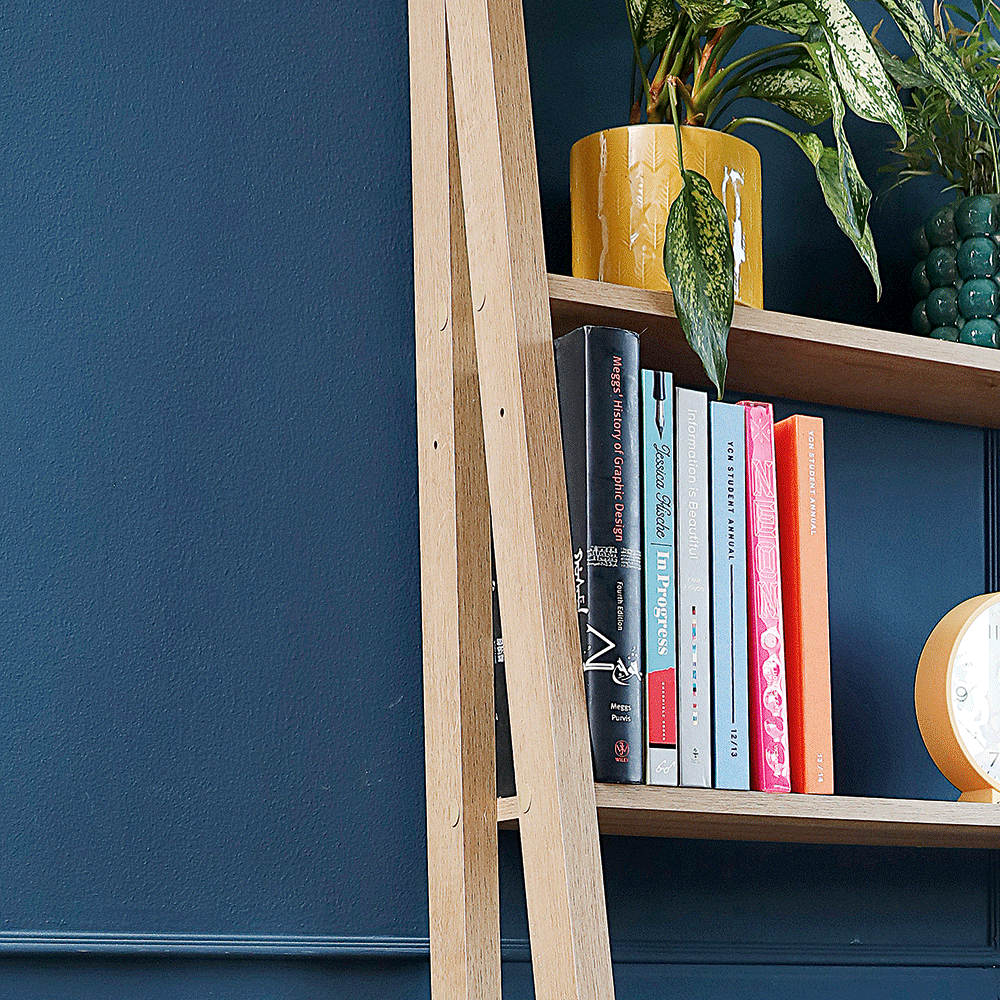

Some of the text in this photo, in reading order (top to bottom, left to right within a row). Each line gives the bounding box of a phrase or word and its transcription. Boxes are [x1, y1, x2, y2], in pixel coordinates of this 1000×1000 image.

[610, 355, 625, 542] Meggs' History of Graphic Design
[653, 443, 672, 539] Jessica Hische
[687, 408, 699, 559] Information is Beautiful
[727, 466, 735, 513] STUDENT
[808, 452, 816, 495] STUDENT
[809, 498, 817, 535] ANNUAL
[727, 519, 735, 560] ANNUAL
[616, 581, 624, 631] Fourth Edition
[654, 550, 671, 656] In Progress
[988, 624, 998, 640] 11
[610, 702, 632, 712] Meggs
[956, 686, 968, 702] 9
[611, 714, 632, 722] Purvis
[730, 729, 738, 758] 12/13
[989, 752, 1000, 767] 7
